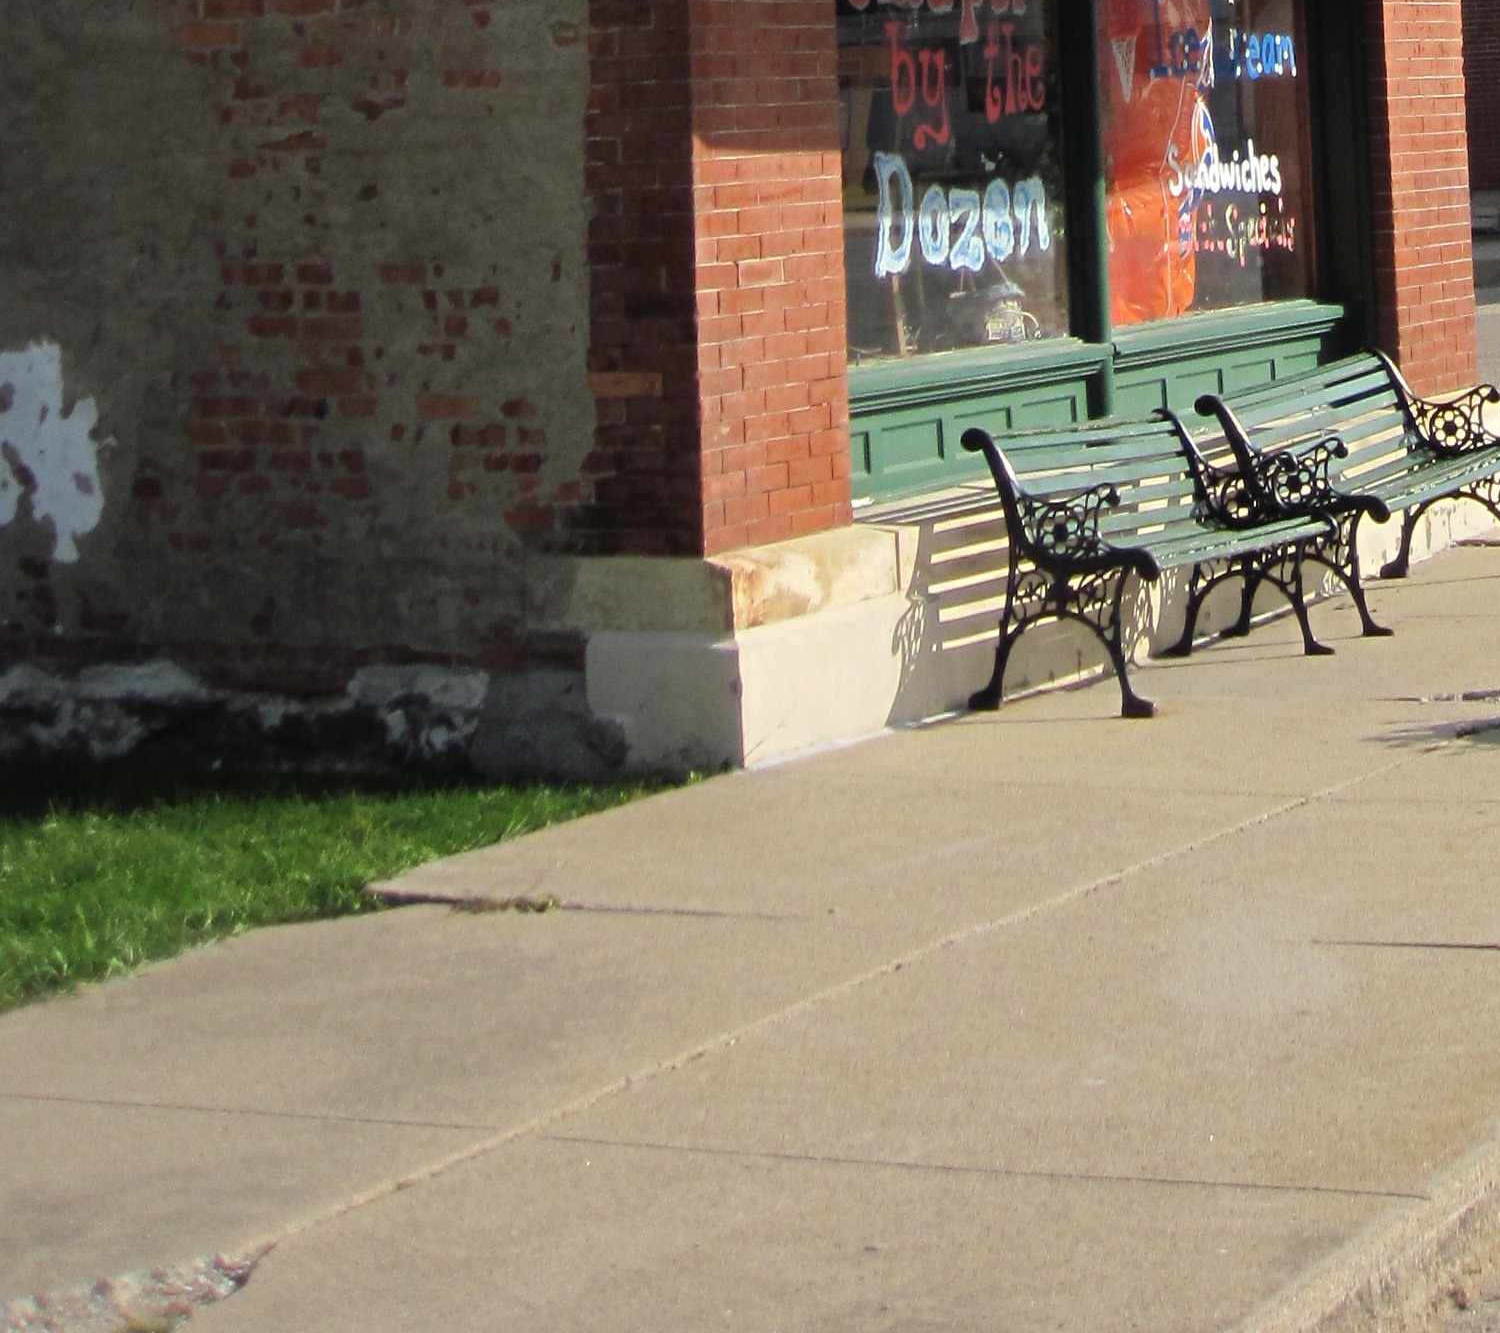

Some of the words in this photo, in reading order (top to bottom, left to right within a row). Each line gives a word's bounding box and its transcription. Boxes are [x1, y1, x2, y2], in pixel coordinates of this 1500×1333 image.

[884, 20, 948, 150] by
[983, 21, 1045, 124] the
[874, 150, 1050, 279] Dozen
